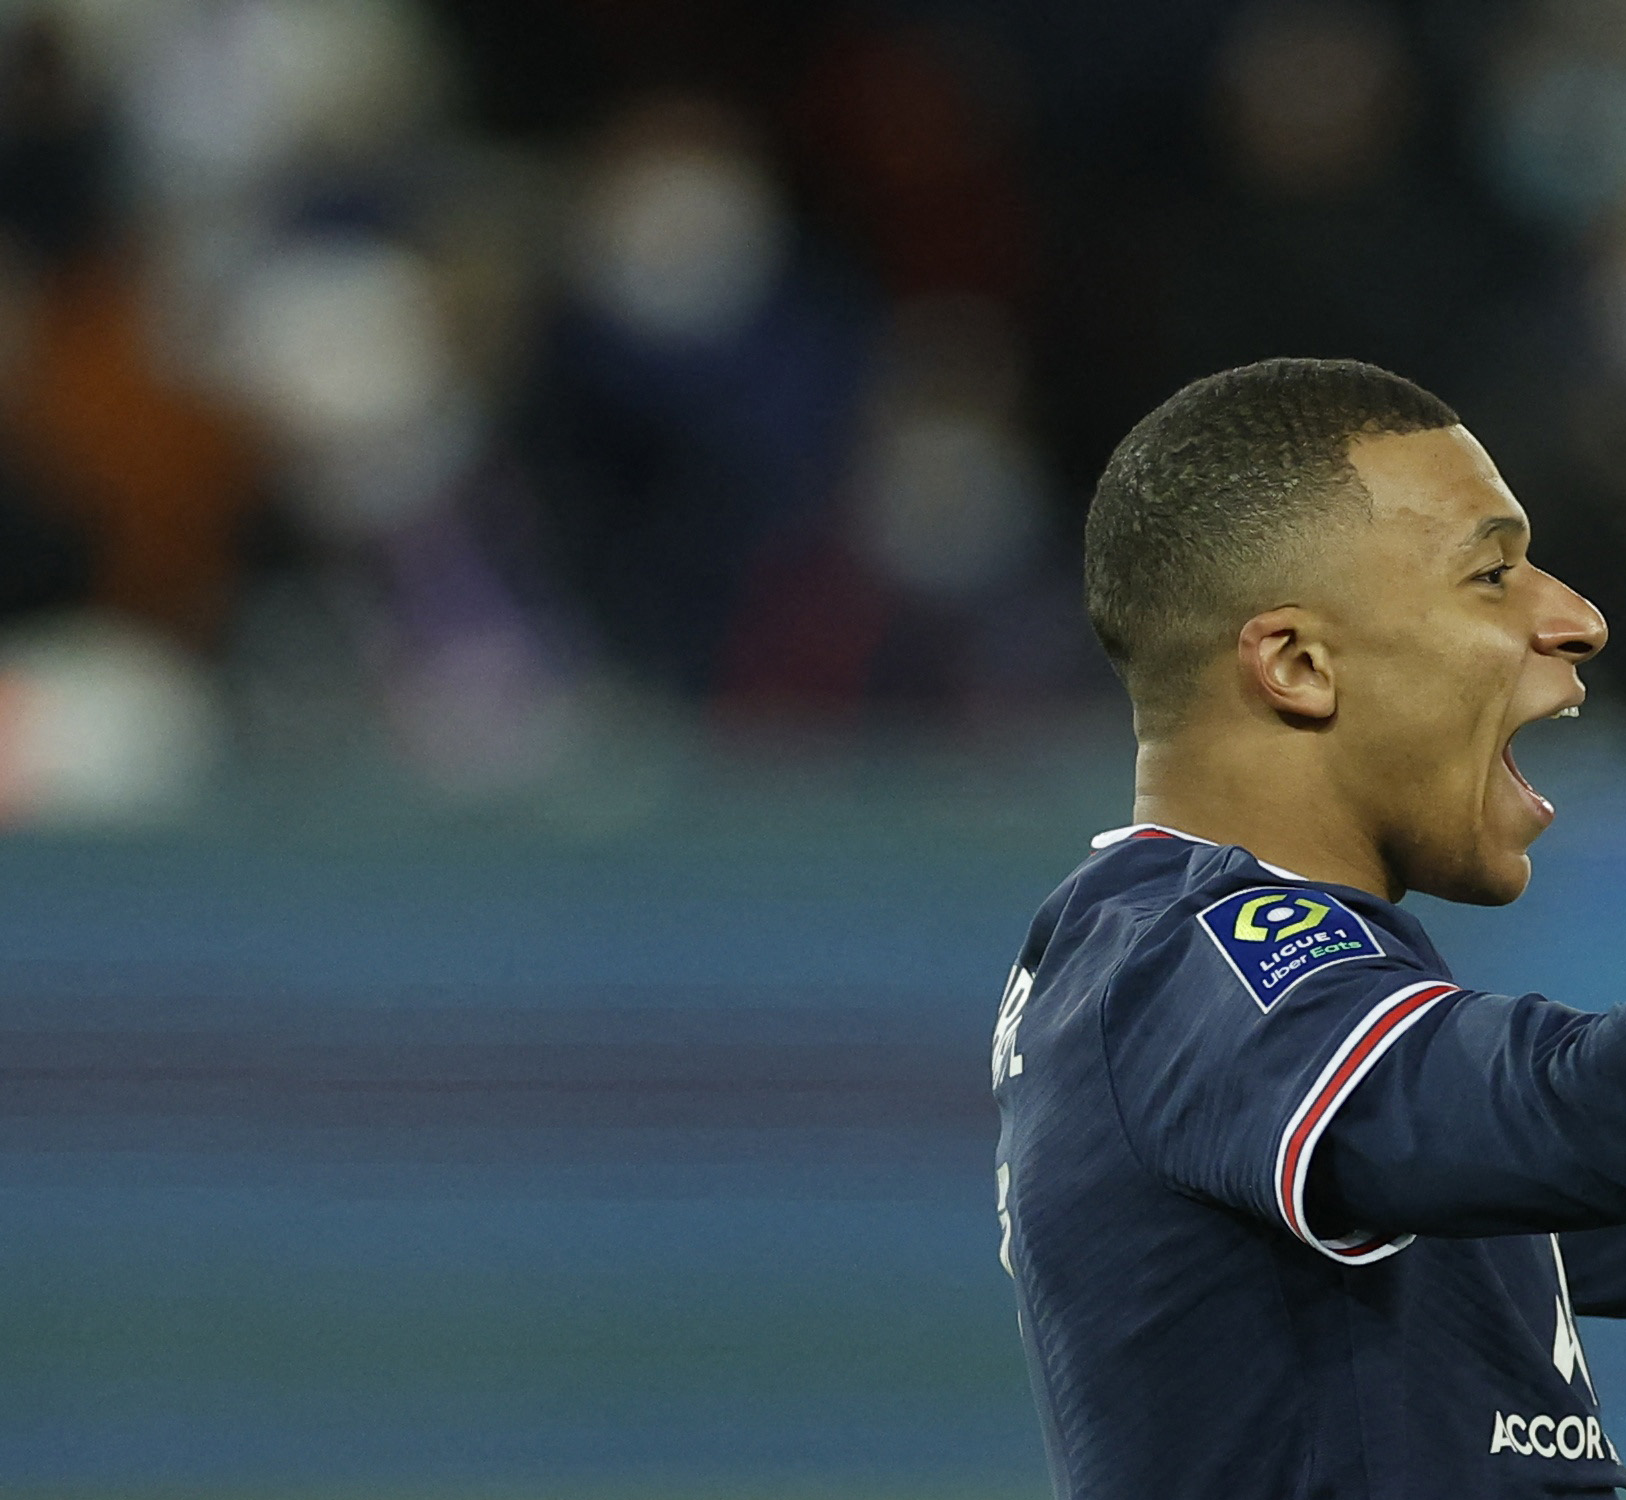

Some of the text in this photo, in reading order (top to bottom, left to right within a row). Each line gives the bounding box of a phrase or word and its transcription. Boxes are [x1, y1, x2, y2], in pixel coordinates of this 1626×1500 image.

[1259, 928, 1348, 971] LIGUE 1
[1262, 939, 1363, 988] Uber Eats
[1490, 1410, 1605, 1460] ACCOR
